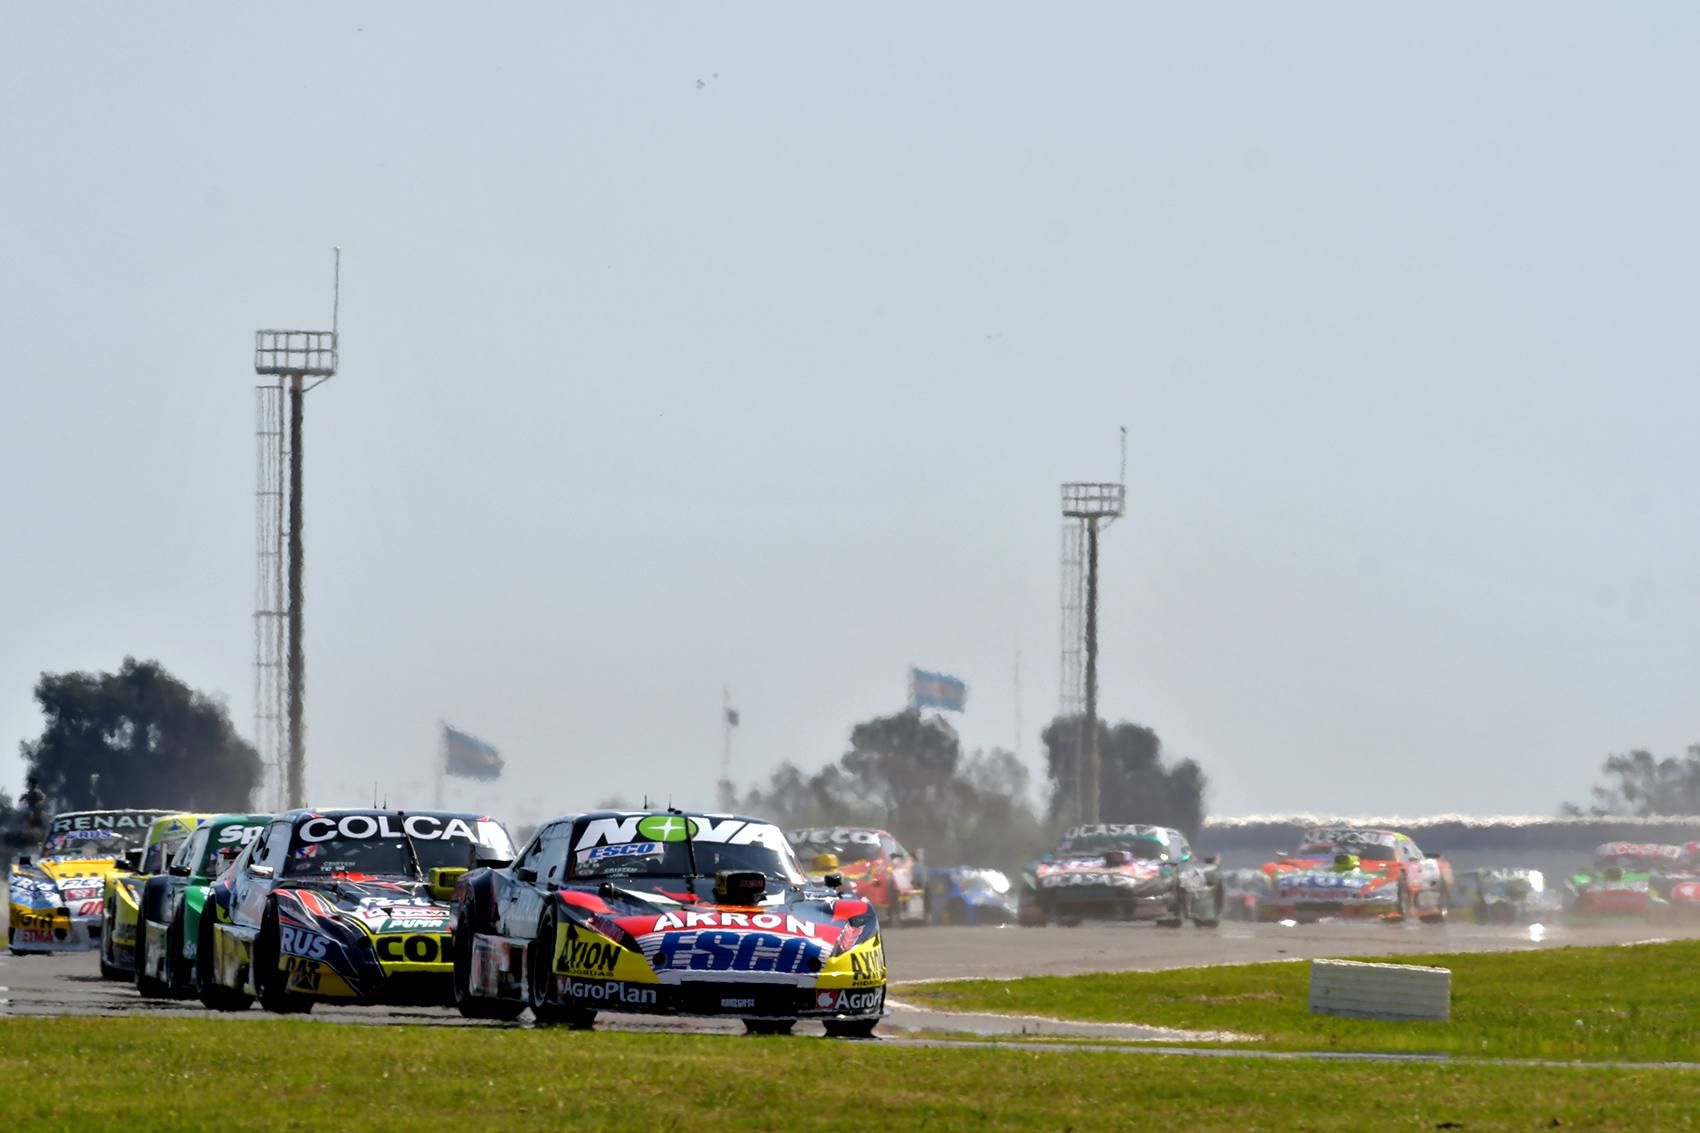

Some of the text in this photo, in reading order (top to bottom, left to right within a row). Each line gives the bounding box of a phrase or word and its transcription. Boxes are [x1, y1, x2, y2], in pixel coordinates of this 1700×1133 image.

[574, 815, 783, 851] NOVA
[588, 843, 656, 858] ESCO
[388, 918, 443, 929] PUMA
[653, 911, 816, 937] AKRON
[658, 930, 823, 973] ESCO
